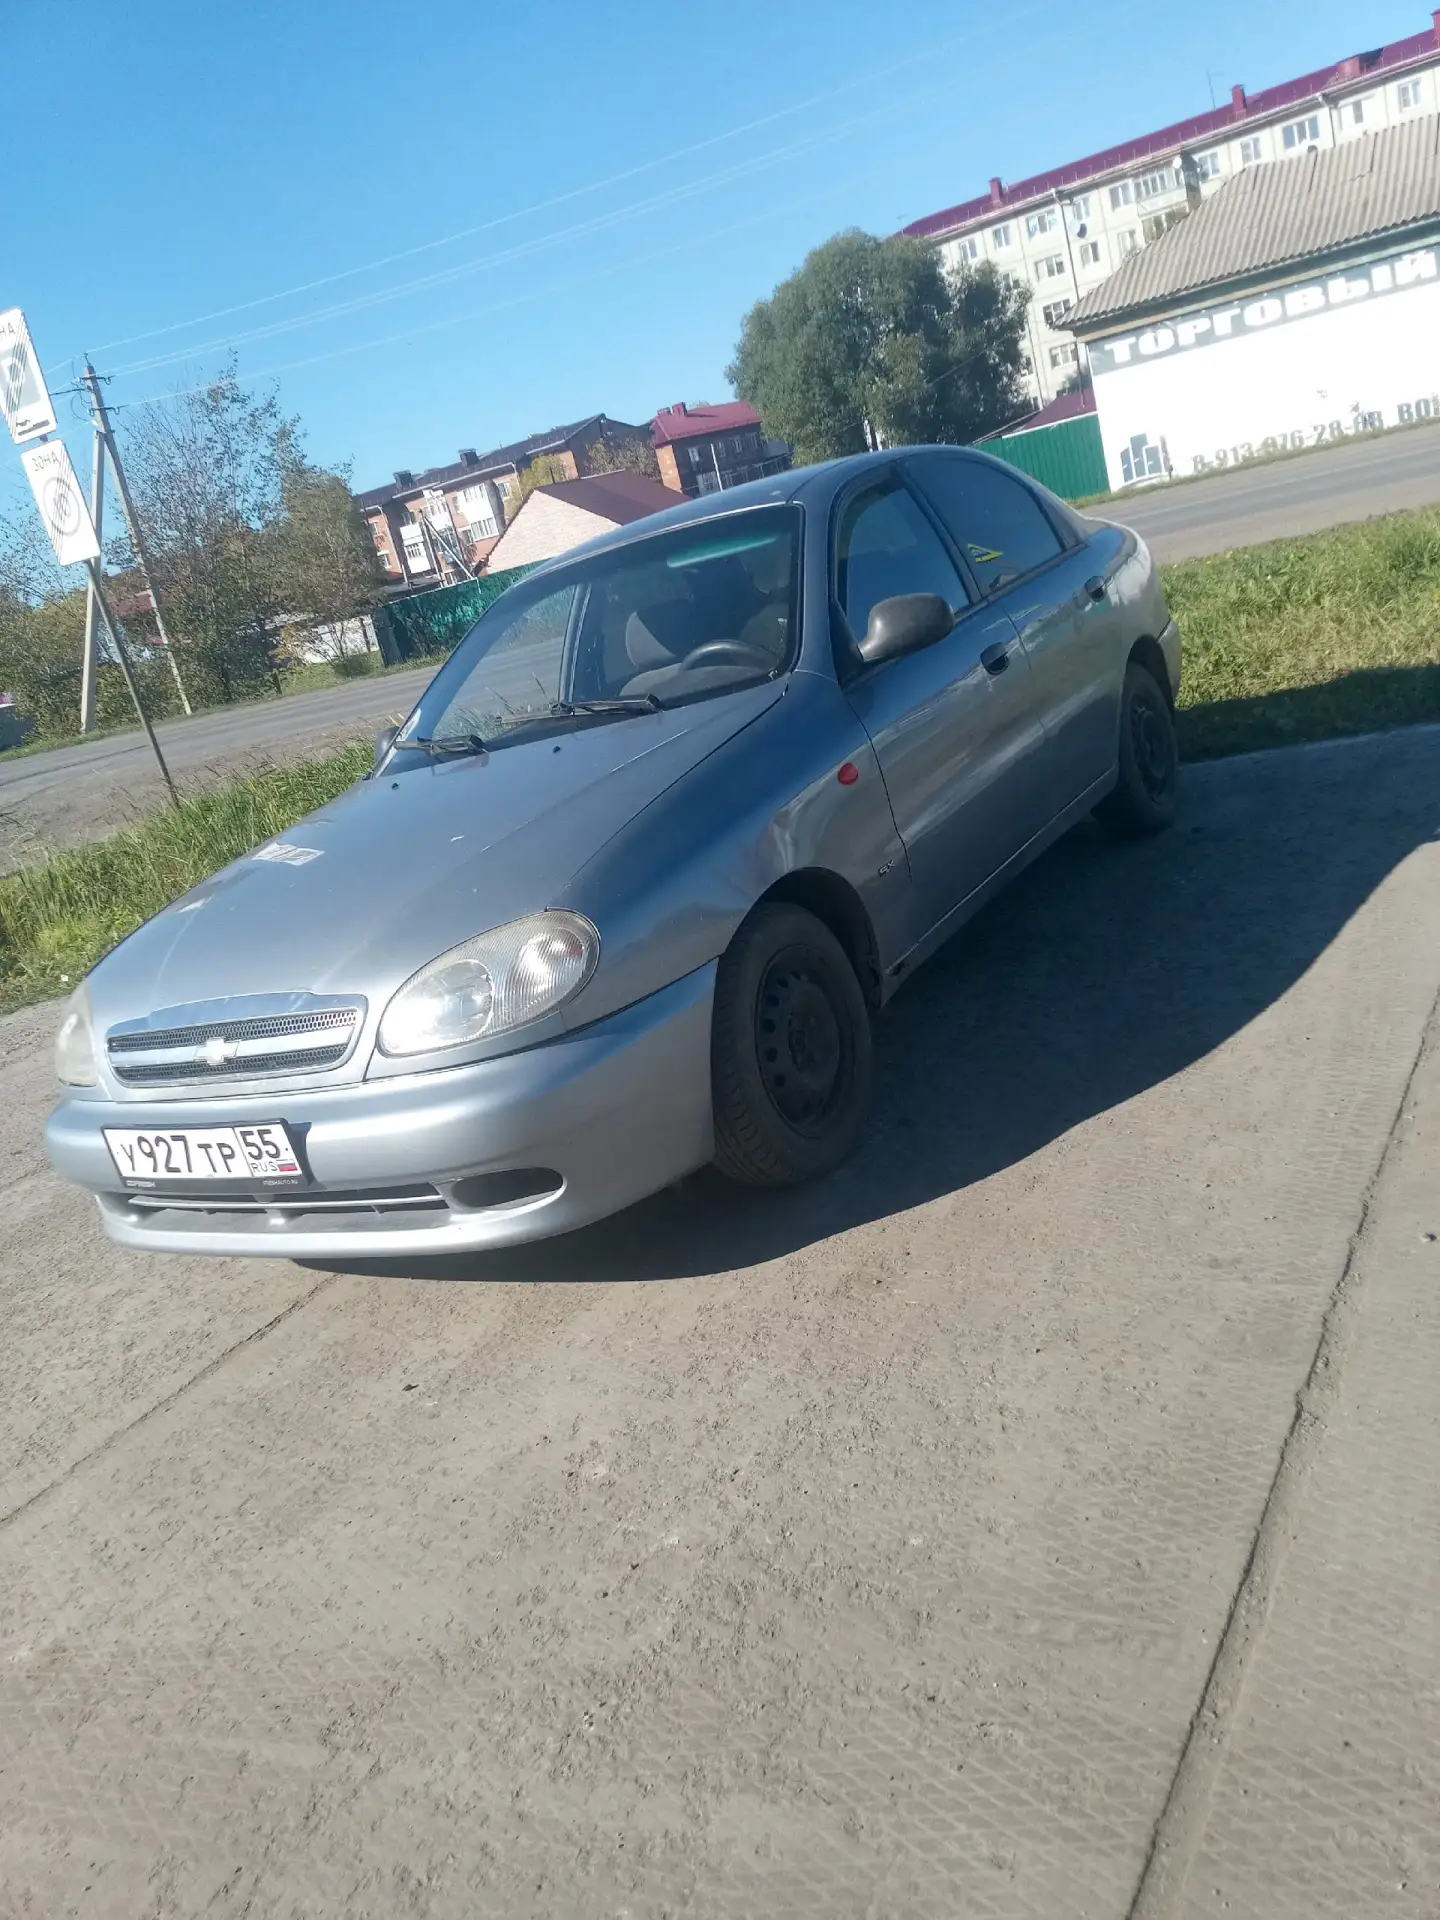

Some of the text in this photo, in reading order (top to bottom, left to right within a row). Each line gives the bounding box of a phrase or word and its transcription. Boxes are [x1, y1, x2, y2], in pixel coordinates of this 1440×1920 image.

[1104, 249, 1437, 364] ТОРГОВЫЙ
[32, 451, 61, 471] ЗОНА
[240, 1129, 281, 1160] 55
[251, 1161, 278, 1173] RUS
